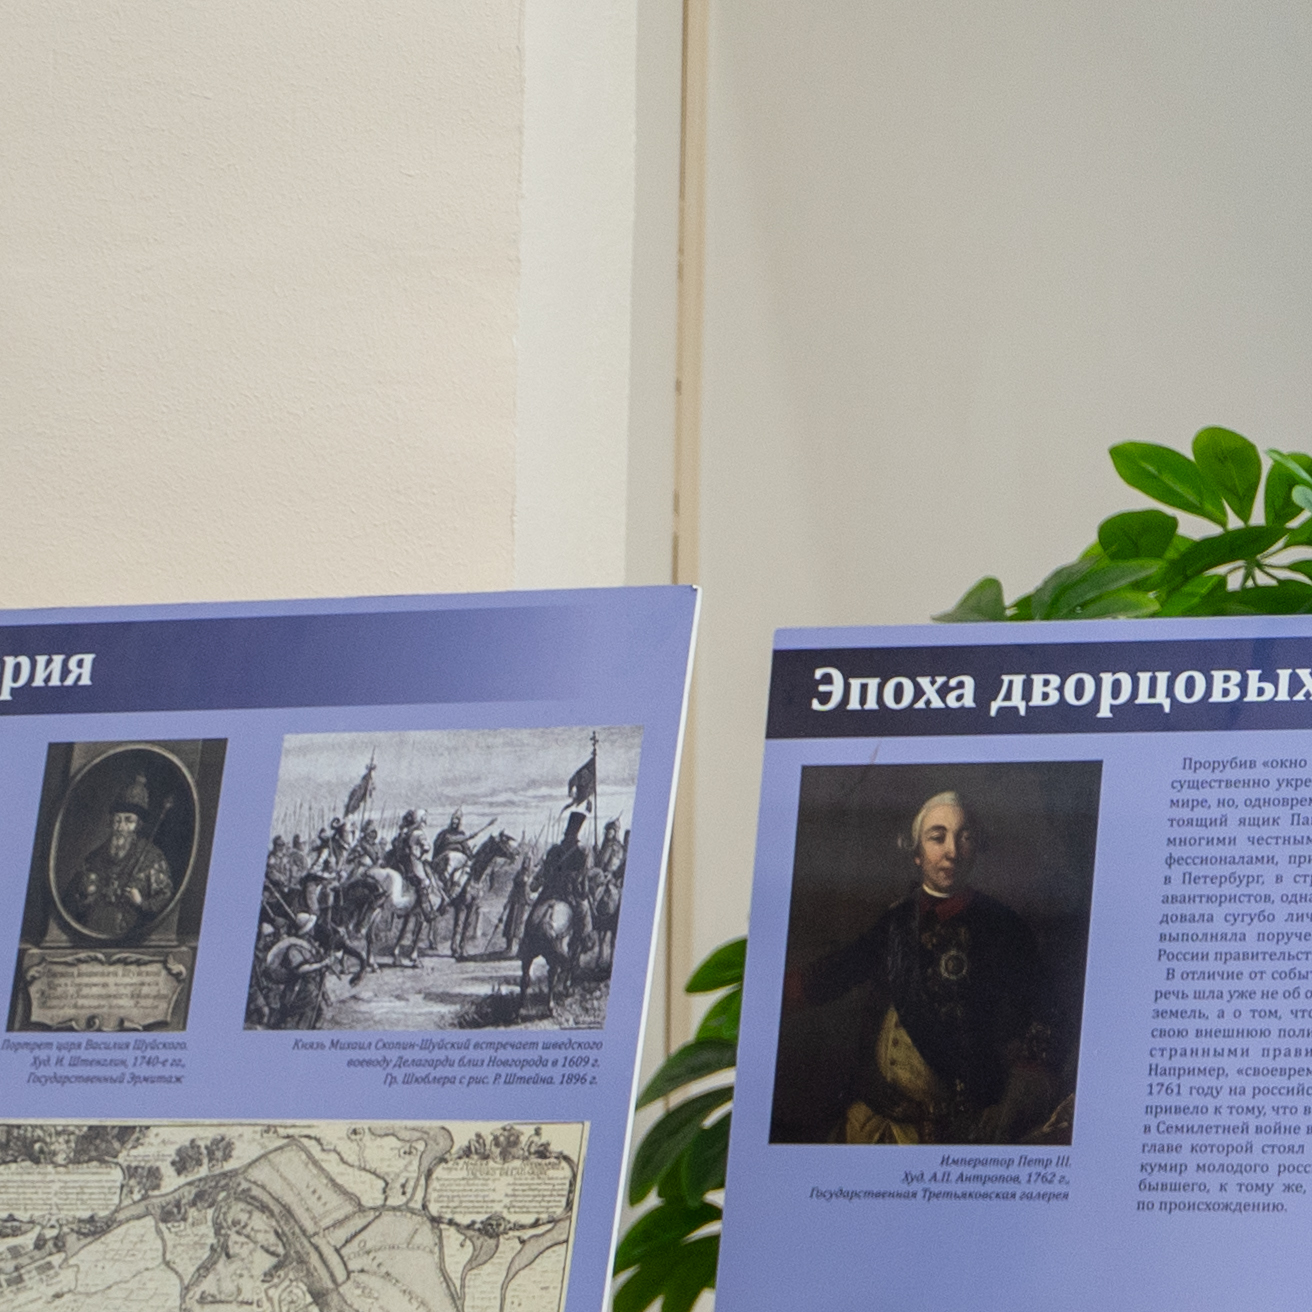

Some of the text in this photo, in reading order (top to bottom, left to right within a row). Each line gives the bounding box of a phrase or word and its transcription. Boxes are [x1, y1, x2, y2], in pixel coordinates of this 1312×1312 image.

[810, 665, 977, 712] Эпоха
[1182, 756, 1307, 773] Прорубив «окно
[291, 1037, 603, 1053] Князь Михаил Скопин-Шуйский встречает шведского
[346, 1055, 392, 1070] воеводу
[392, 1055, 455, 1070] Делагарди
[457, 1055, 484, 1067] близ
[486, 1055, 548, 1070] Новгорода
[561, 1055, 590, 1067] 1609
[401, 1072, 456, 1087] Шюблера
[558, 1072, 587, 1085] 1896
[1141, 1140, 1304, 1156] главе которой стоял
[1138, 1178, 1306, 1195] бывшего, к тому же,
[1136, 1200, 1286, 1215] по происхождению.
